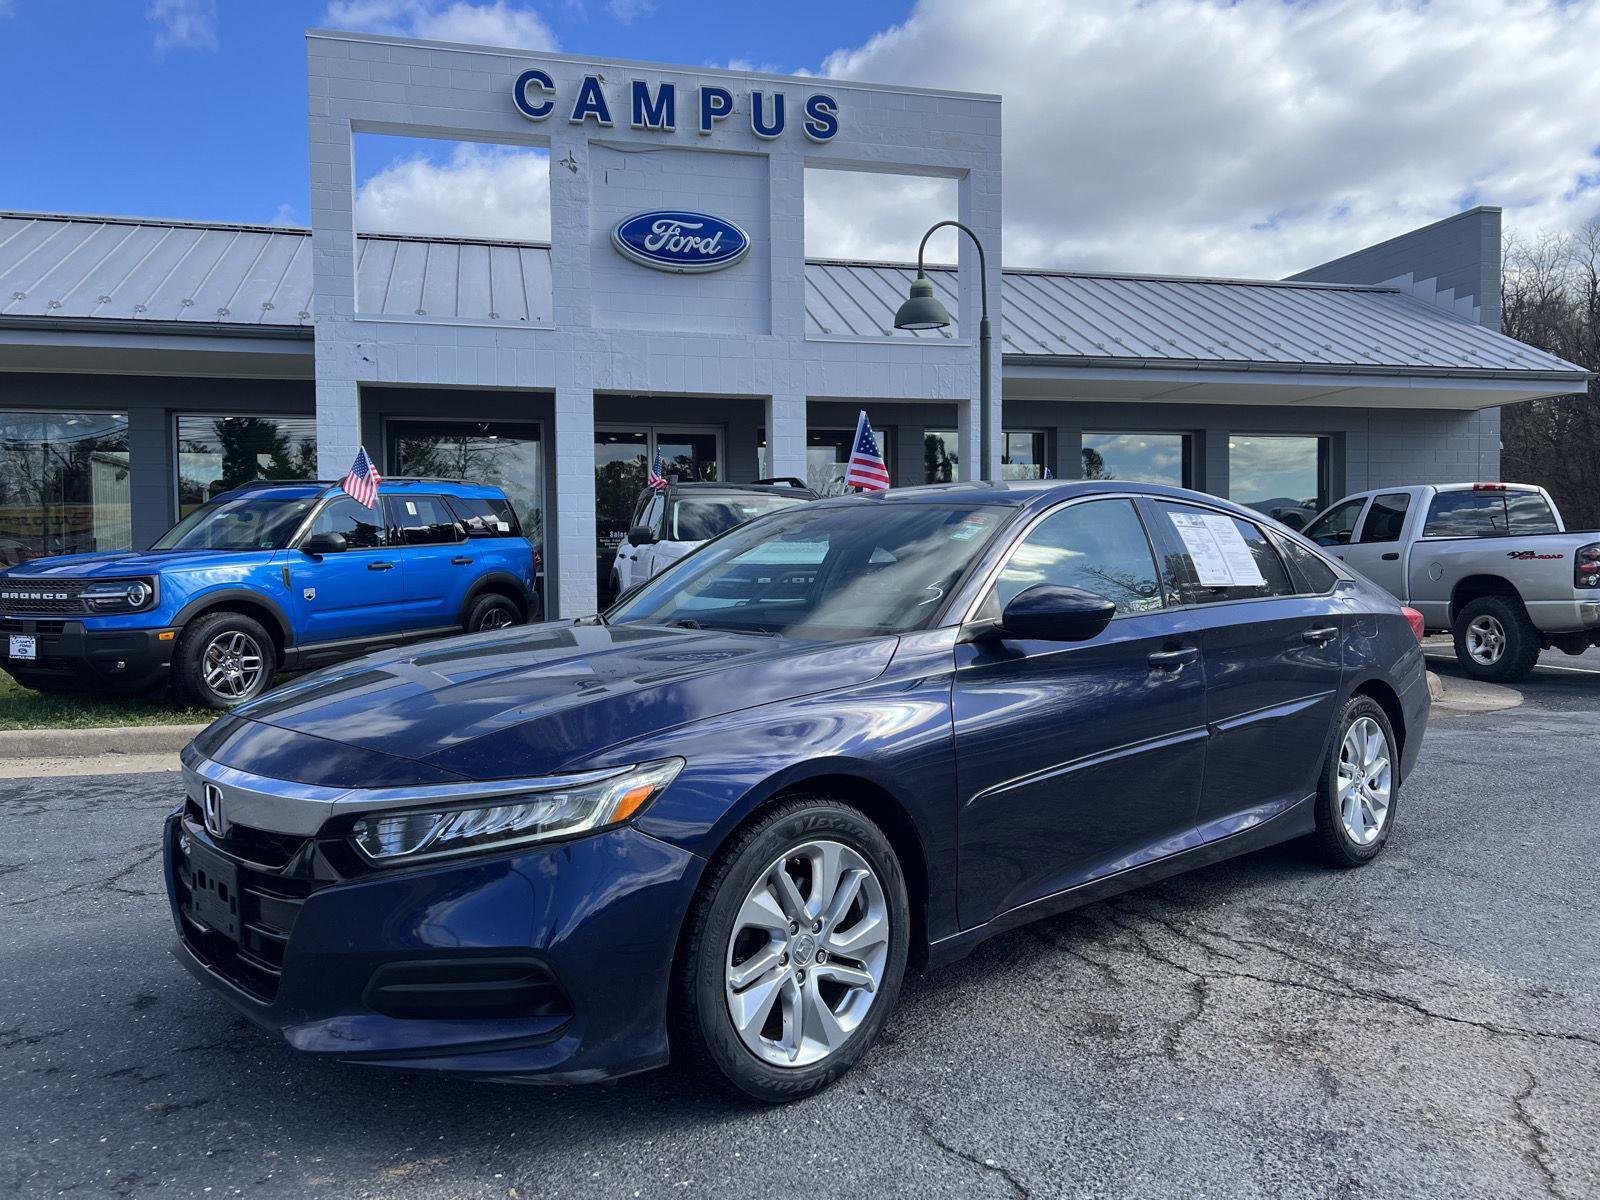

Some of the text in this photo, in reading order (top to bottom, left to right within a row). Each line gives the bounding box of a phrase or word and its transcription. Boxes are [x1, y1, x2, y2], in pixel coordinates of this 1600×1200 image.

[512, 68, 840, 143] CAMPUS
[644, 218, 723, 256] Ford
[1, 592, 68, 600] BRONCO
